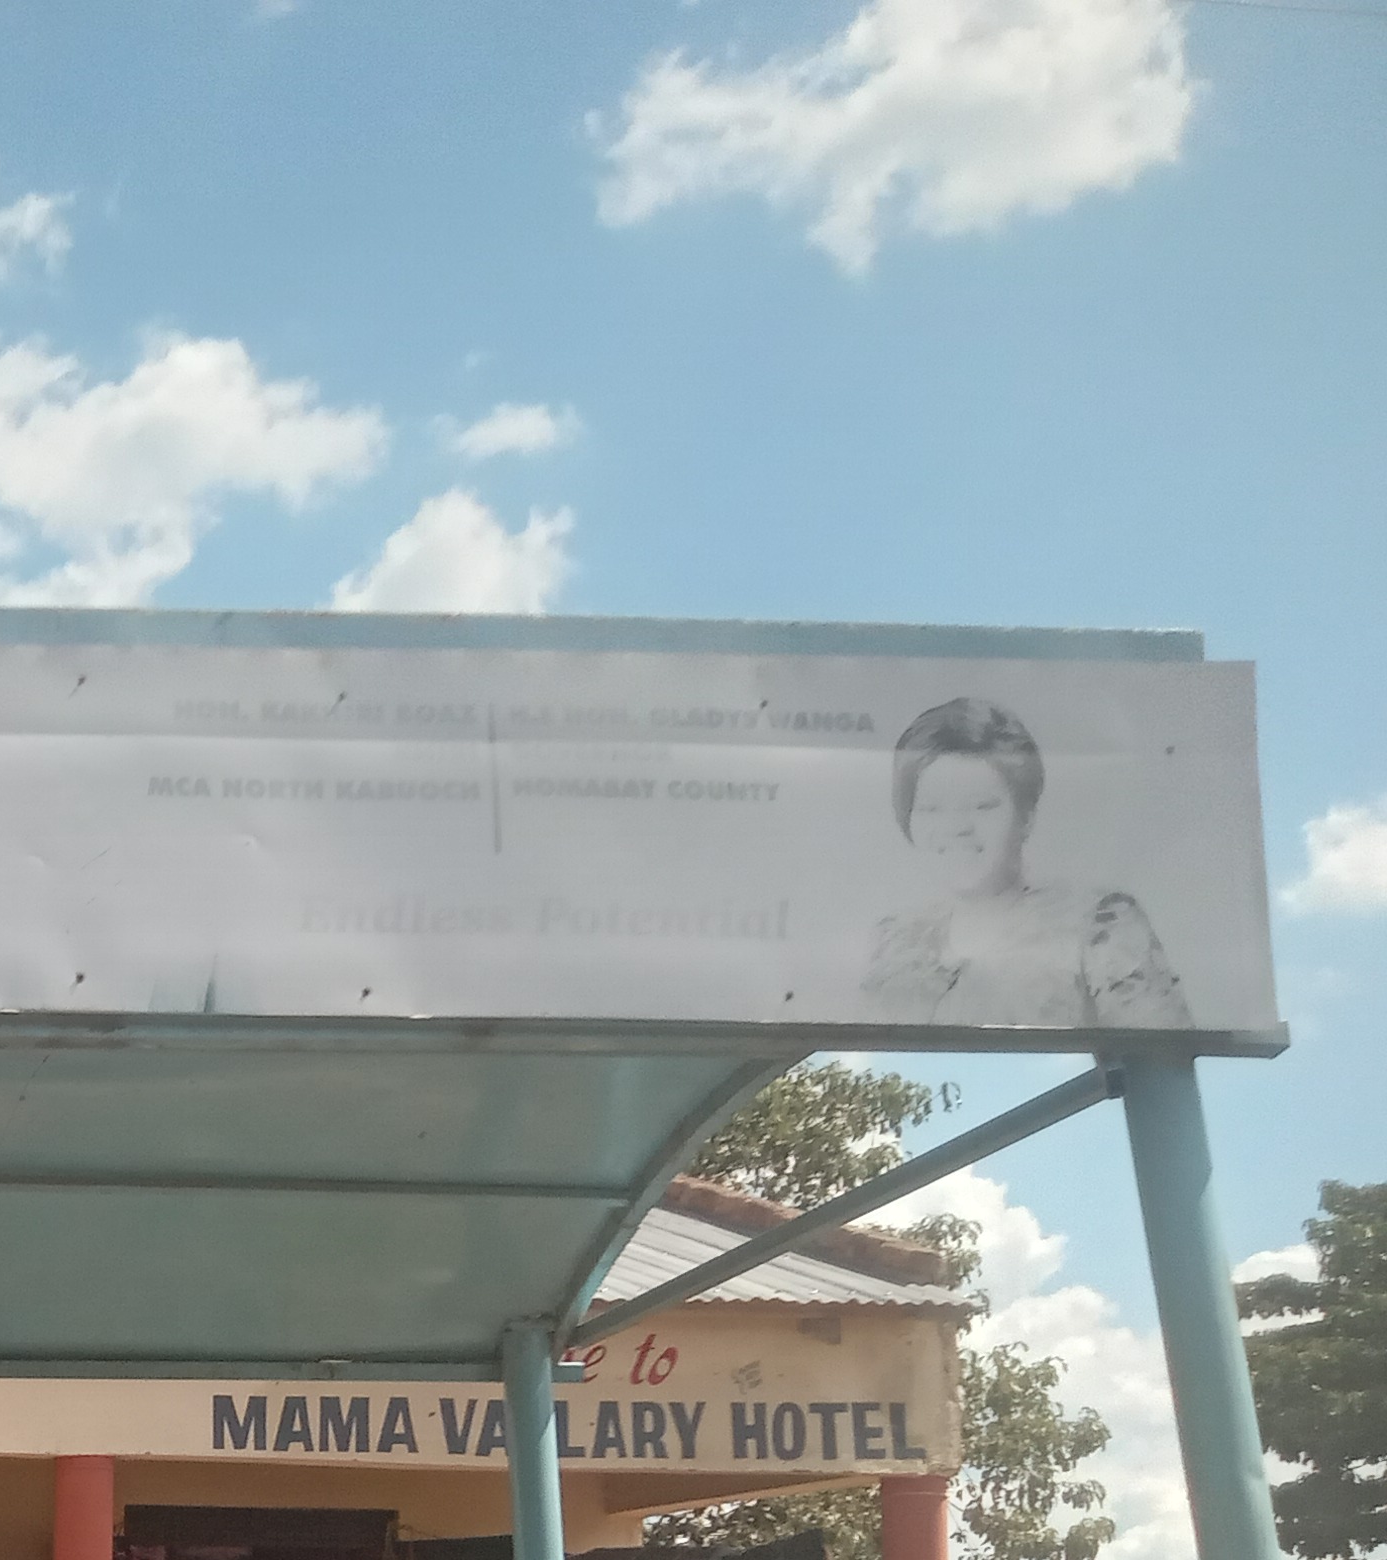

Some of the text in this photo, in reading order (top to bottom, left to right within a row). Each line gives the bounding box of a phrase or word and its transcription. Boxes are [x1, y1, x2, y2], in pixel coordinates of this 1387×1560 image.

[147, 776, 211, 797] MCA
[222, 777, 324, 799] NORTH
[667, 779, 780, 802] COUNTY
[300, 893, 789, 940] Endless Potential
[629, 1333, 679, 1386] to
[212, 1394, 927, 1462] MAMA VALARY HOTEL
